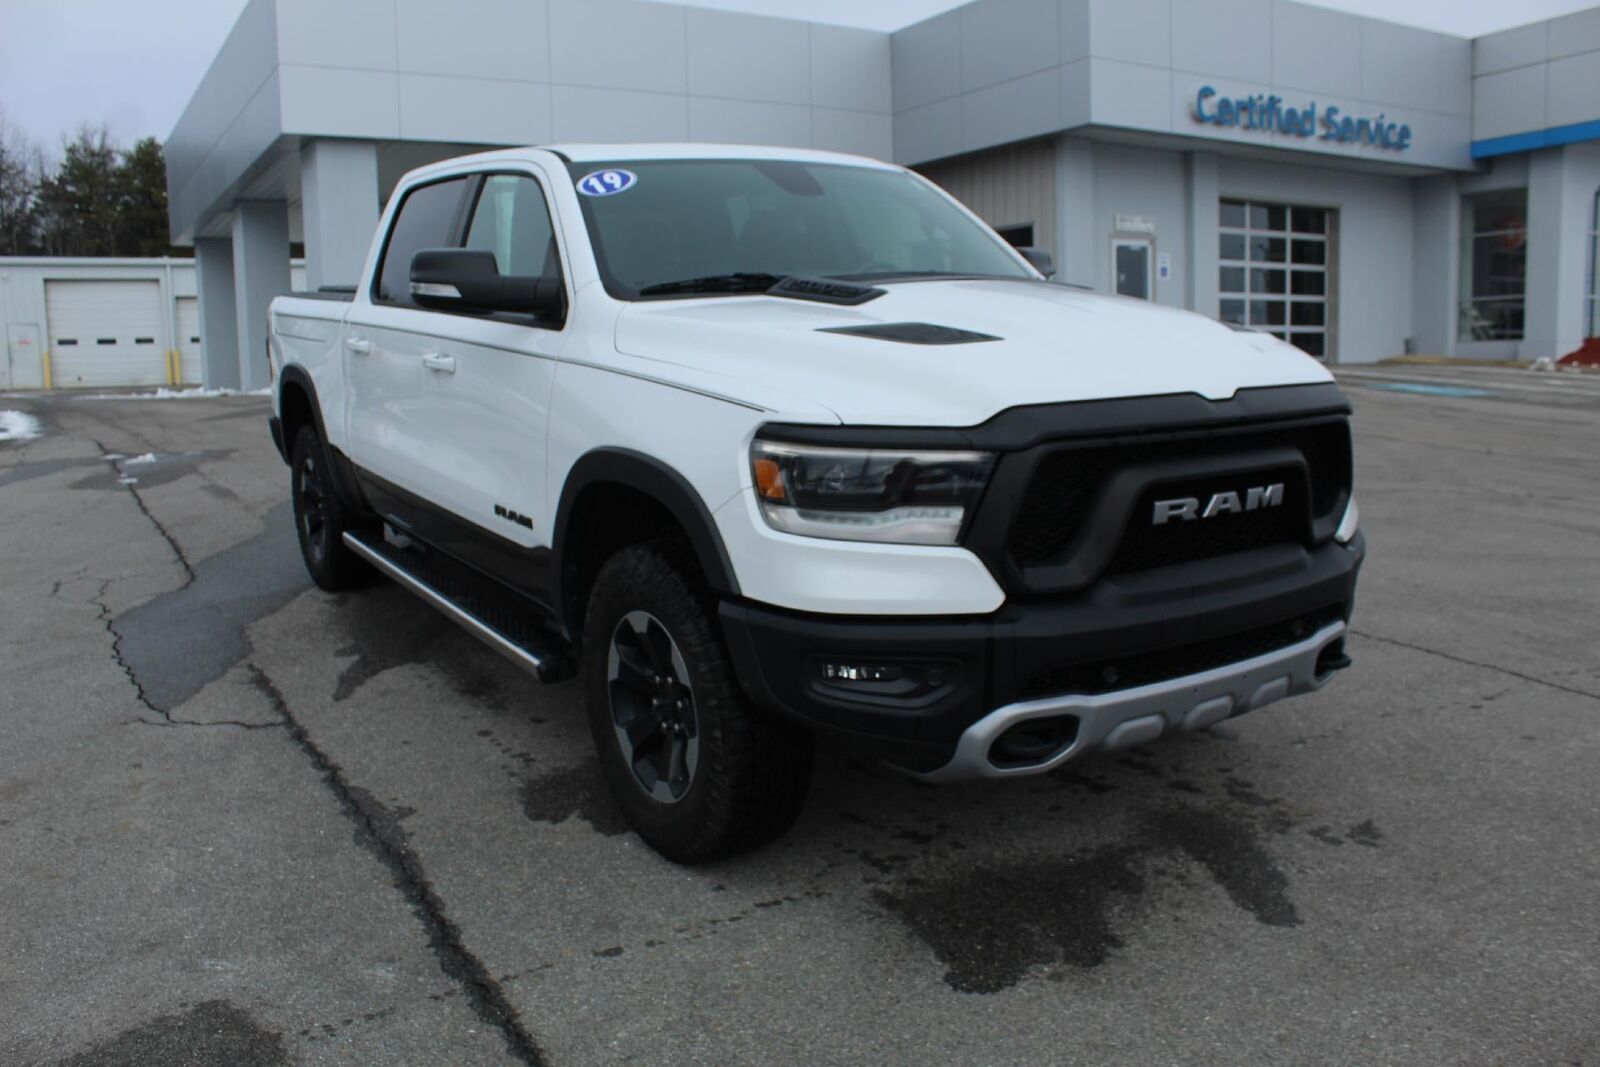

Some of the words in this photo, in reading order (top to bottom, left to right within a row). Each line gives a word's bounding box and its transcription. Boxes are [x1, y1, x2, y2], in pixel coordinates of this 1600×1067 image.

[1194, 85, 1316, 138] Certified
[1321, 105, 1412, 151] Service
[588, 172, 622, 193] 19
[494, 504, 533, 530] RAM
[1152, 483, 1285, 525] RAM
